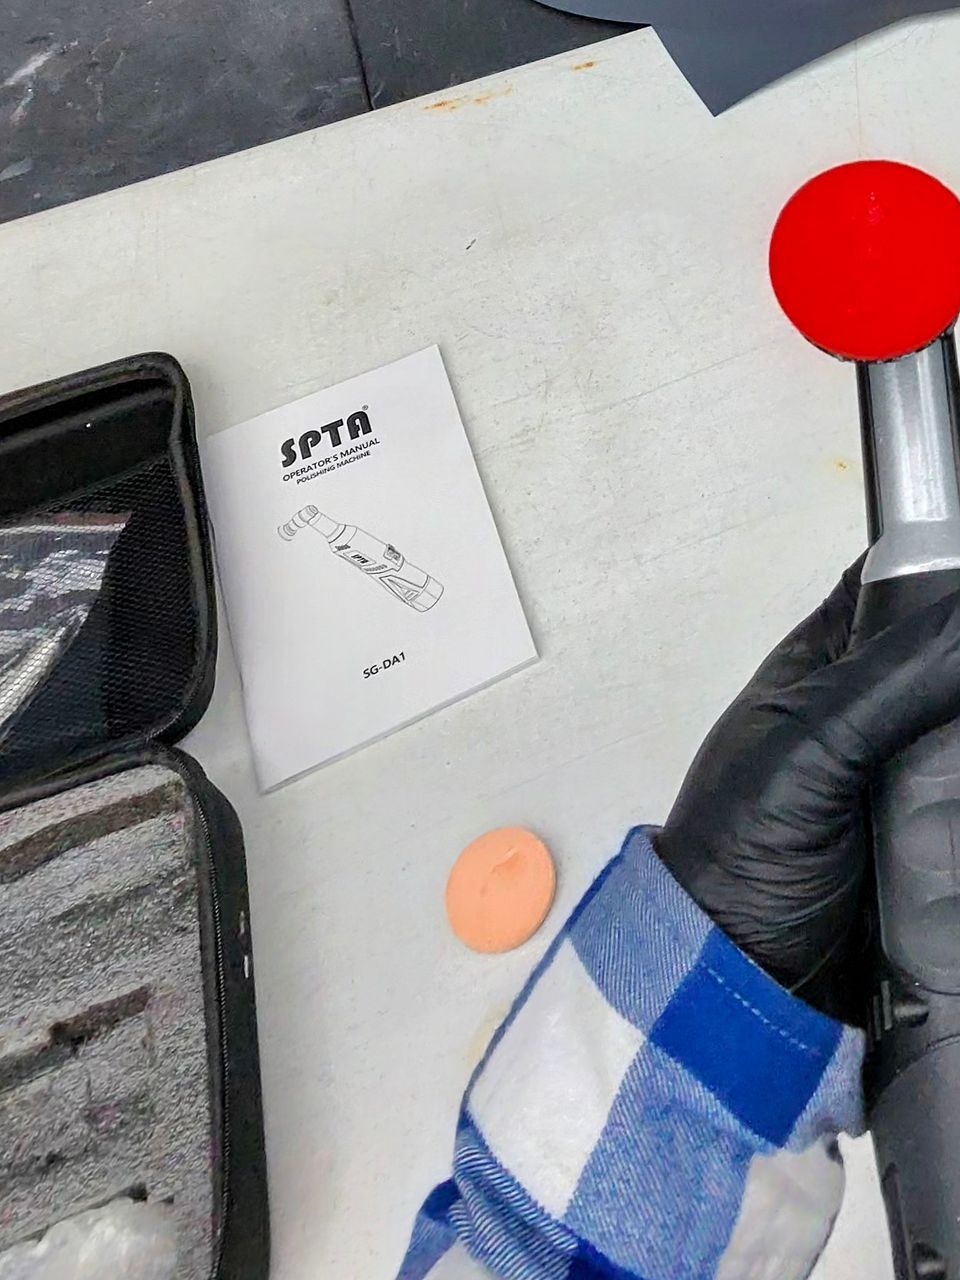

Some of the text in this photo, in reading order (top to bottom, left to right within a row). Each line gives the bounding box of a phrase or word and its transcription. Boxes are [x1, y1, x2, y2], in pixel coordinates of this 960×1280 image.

[281, 410, 373, 468] SPTA
[282, 437, 381, 482] OPERATOR'S MANUAL
[296, 450, 372, 485] POLISHING MACHINE
[362, 651, 407, 680] SG-DA1
